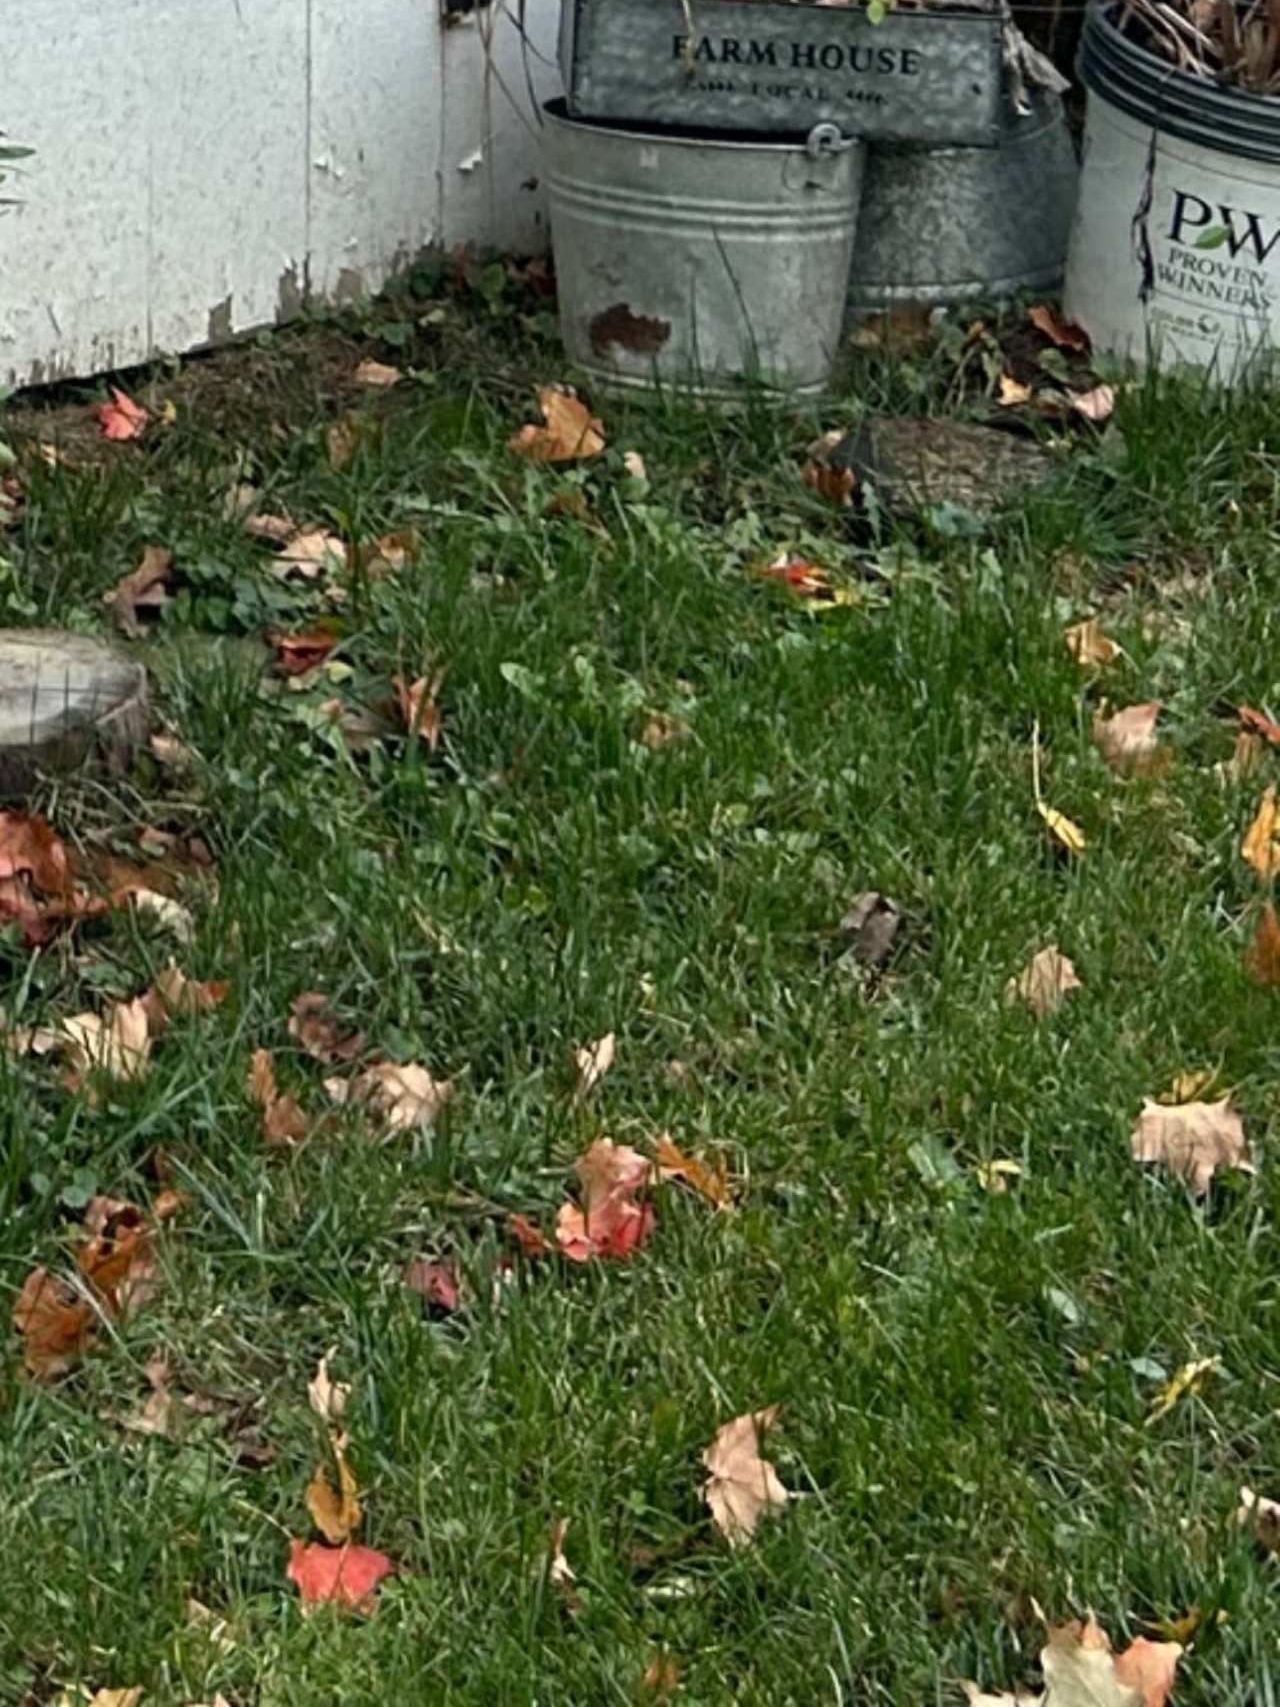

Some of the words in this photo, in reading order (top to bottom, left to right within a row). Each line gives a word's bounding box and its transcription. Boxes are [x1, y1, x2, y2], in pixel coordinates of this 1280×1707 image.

[671, 35, 776, 66] FARM
[791, 42, 921, 75] HOUSE
[1158, 263, 1272, 309] WINNERS
[1168, 247, 1267, 286] PROVEN
